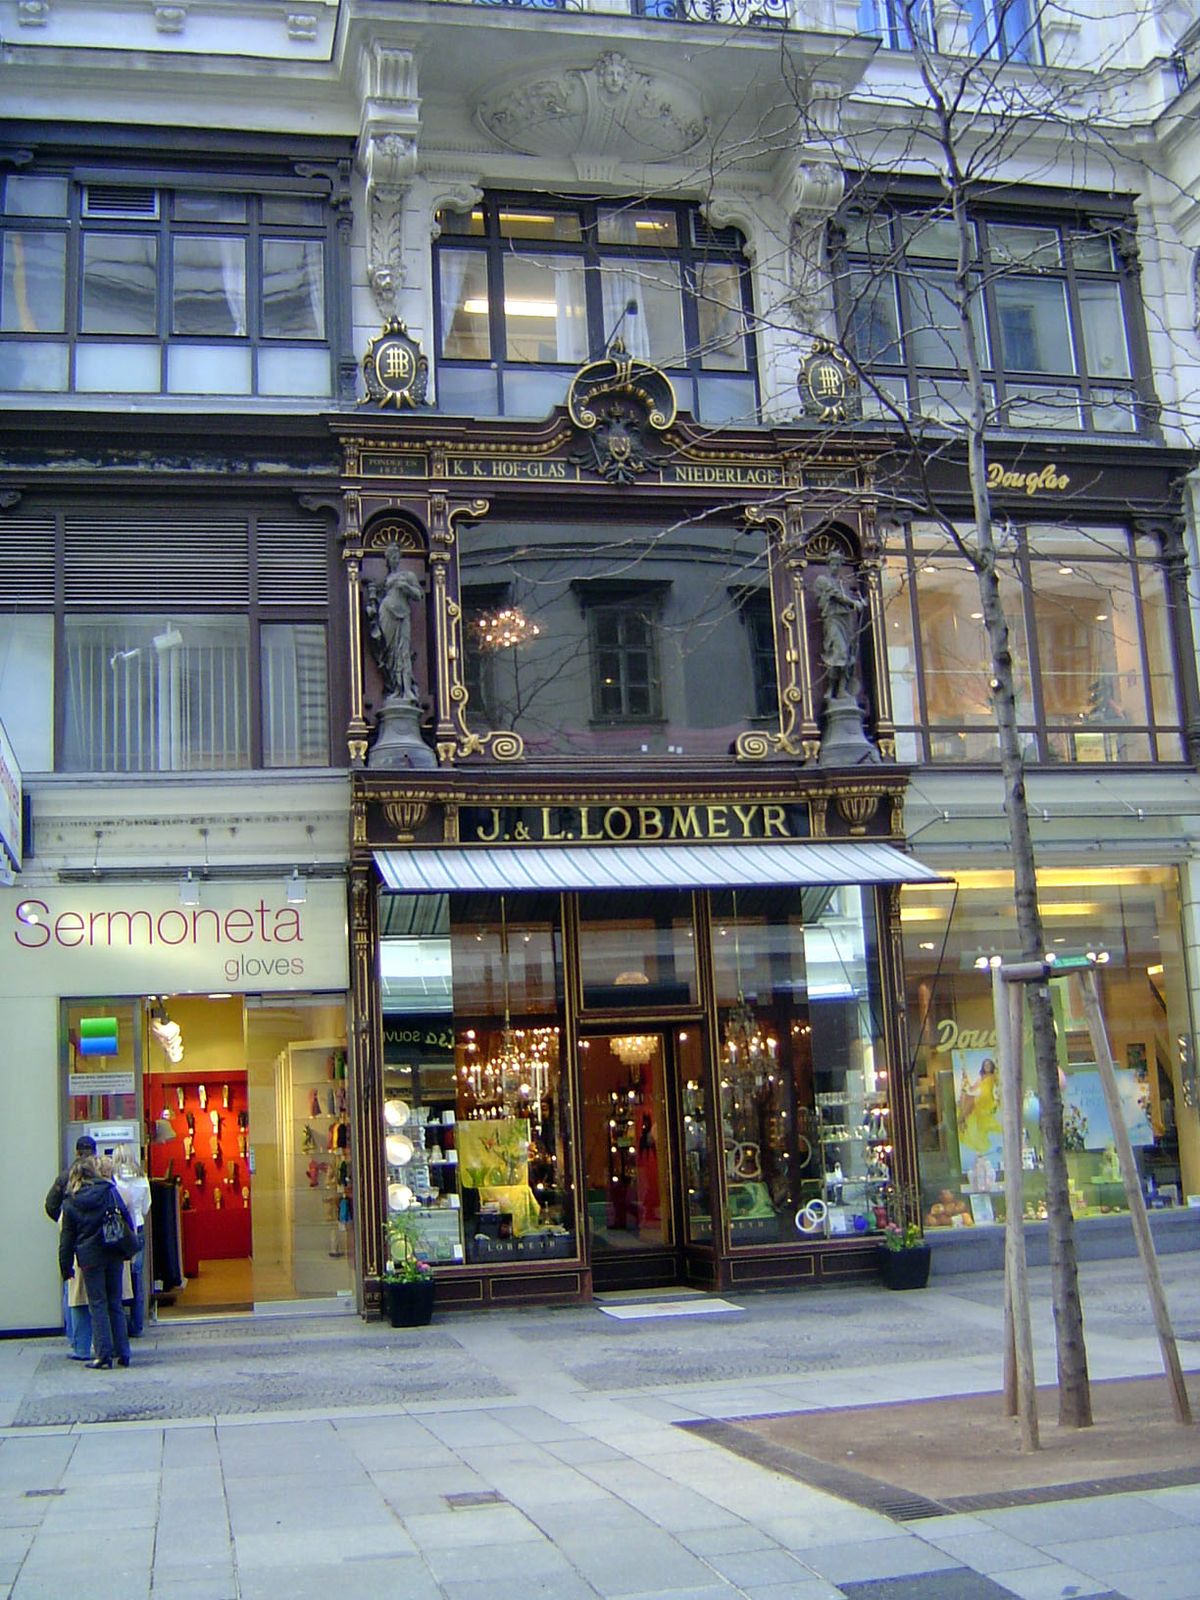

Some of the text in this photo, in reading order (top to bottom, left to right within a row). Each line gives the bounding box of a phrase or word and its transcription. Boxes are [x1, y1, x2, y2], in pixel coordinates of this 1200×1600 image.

[453, 460, 566, 478] K. K. HOF-GLAS
[675, 466, 779, 485] NIEDERLAGE
[986, 462, 1070, 496] Douglas
[14, 899, 304, 948] Sermoneta
[224, 954, 305, 982] gloves
